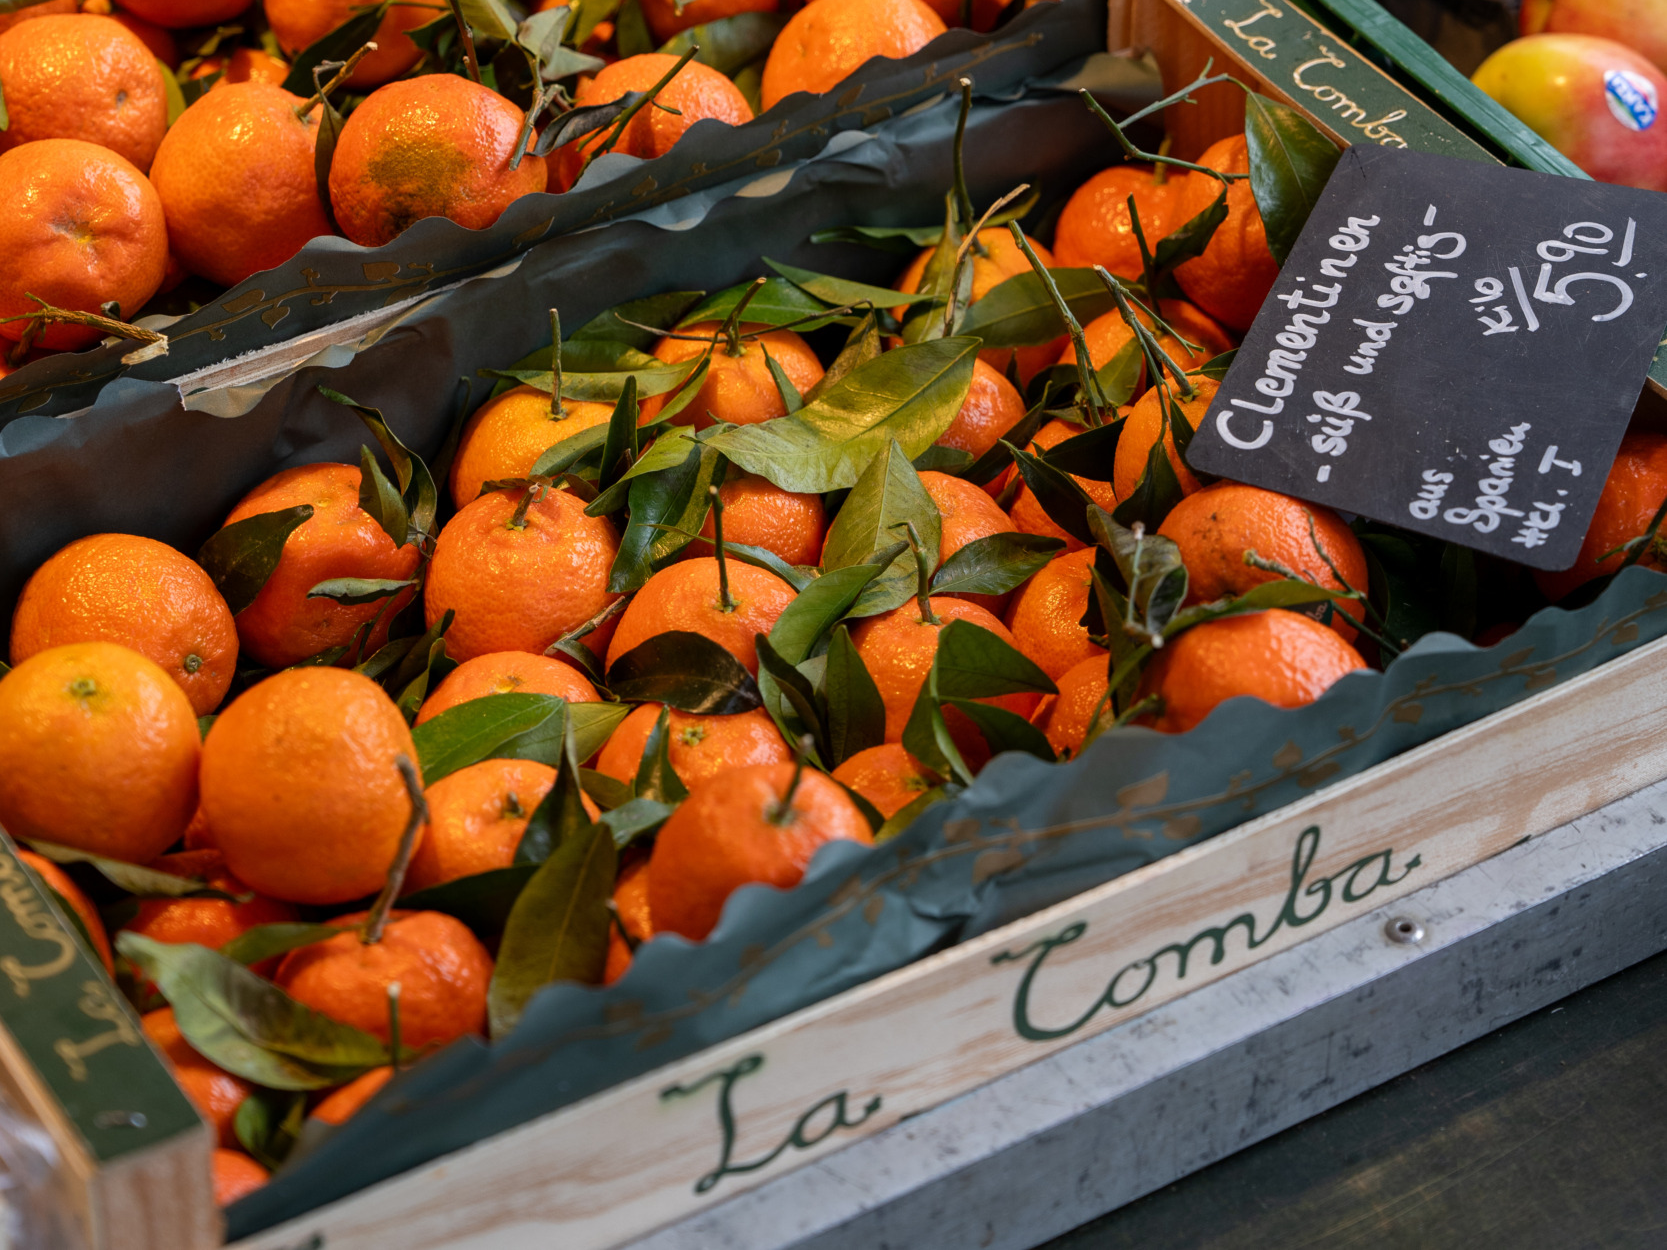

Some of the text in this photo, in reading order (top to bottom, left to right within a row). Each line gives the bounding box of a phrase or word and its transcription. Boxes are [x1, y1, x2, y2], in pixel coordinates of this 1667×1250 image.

[1343, 318, 1398, 375] und
[1408, 469, 1454, 520] aus
[1443, 422, 1532, 534] Spanien
[658, 1052, 883, 1196] La
